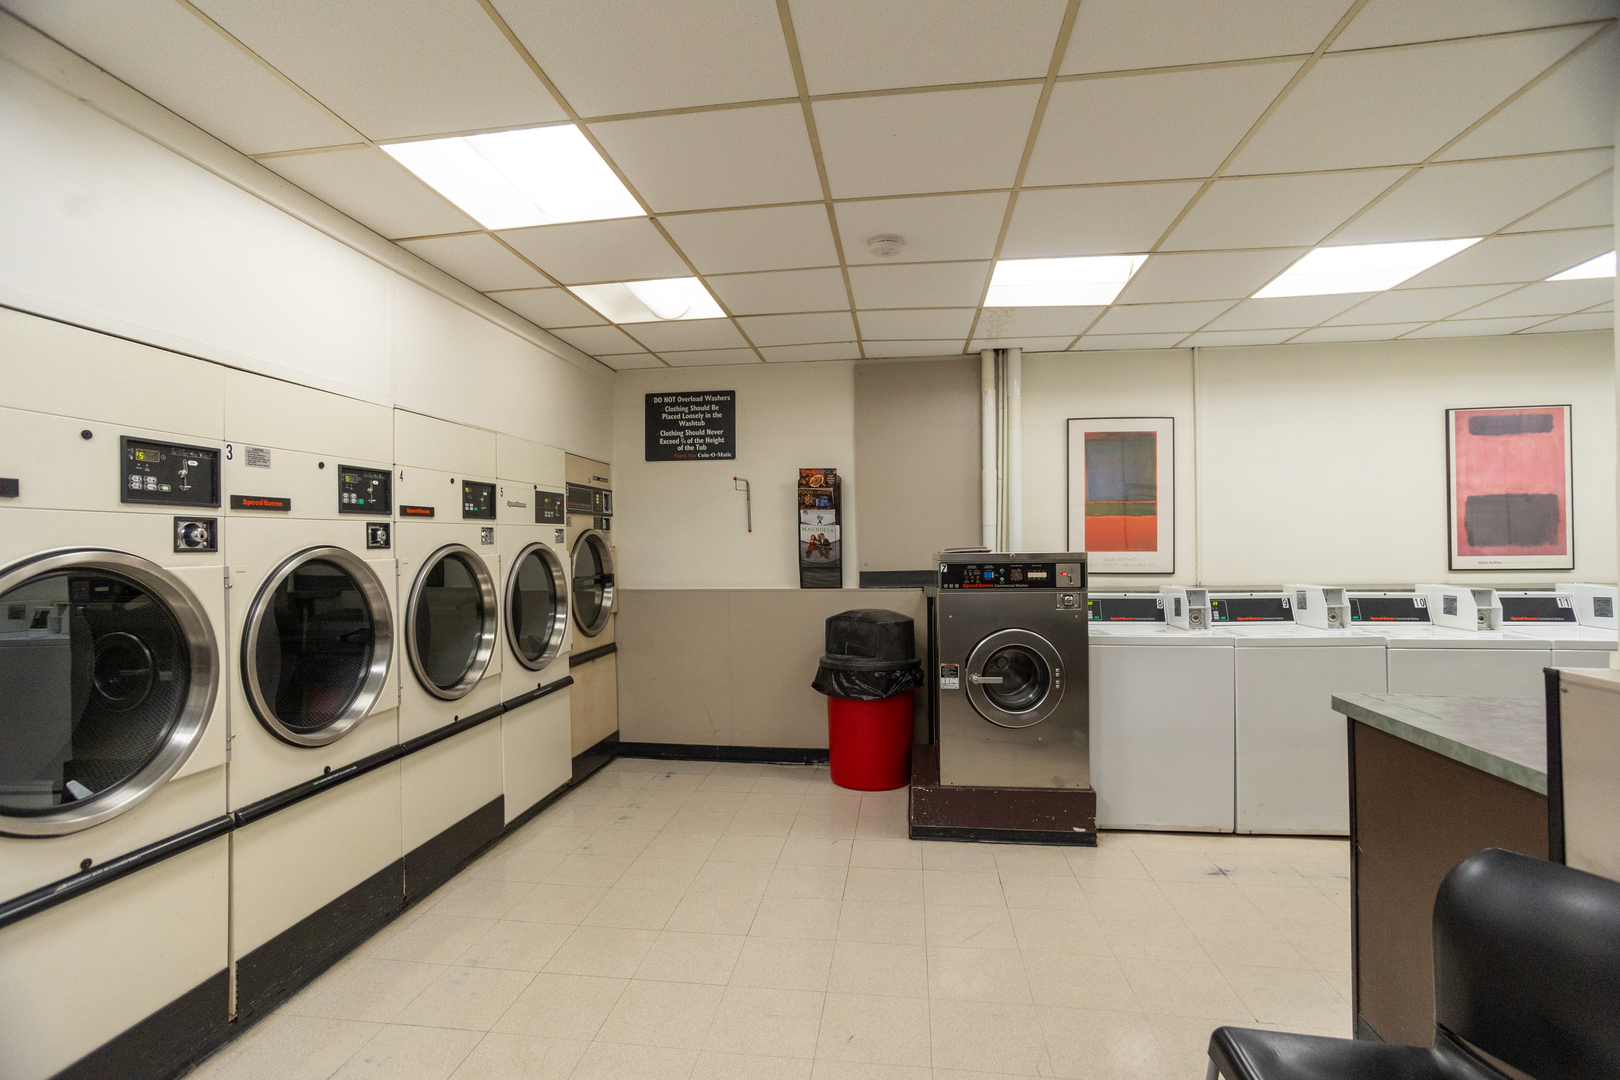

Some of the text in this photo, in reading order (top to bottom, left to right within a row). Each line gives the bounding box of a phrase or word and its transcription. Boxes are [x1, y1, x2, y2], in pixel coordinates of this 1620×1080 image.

[226, 444, 232, 460] 3
[400, 470, 403, 482] 4
[500, 487, 503, 497] 5
[1158, 599, 1162, 608] 8
[1283, 599, 1288, 608] 9
[1558, 598, 1570, 607] 11
